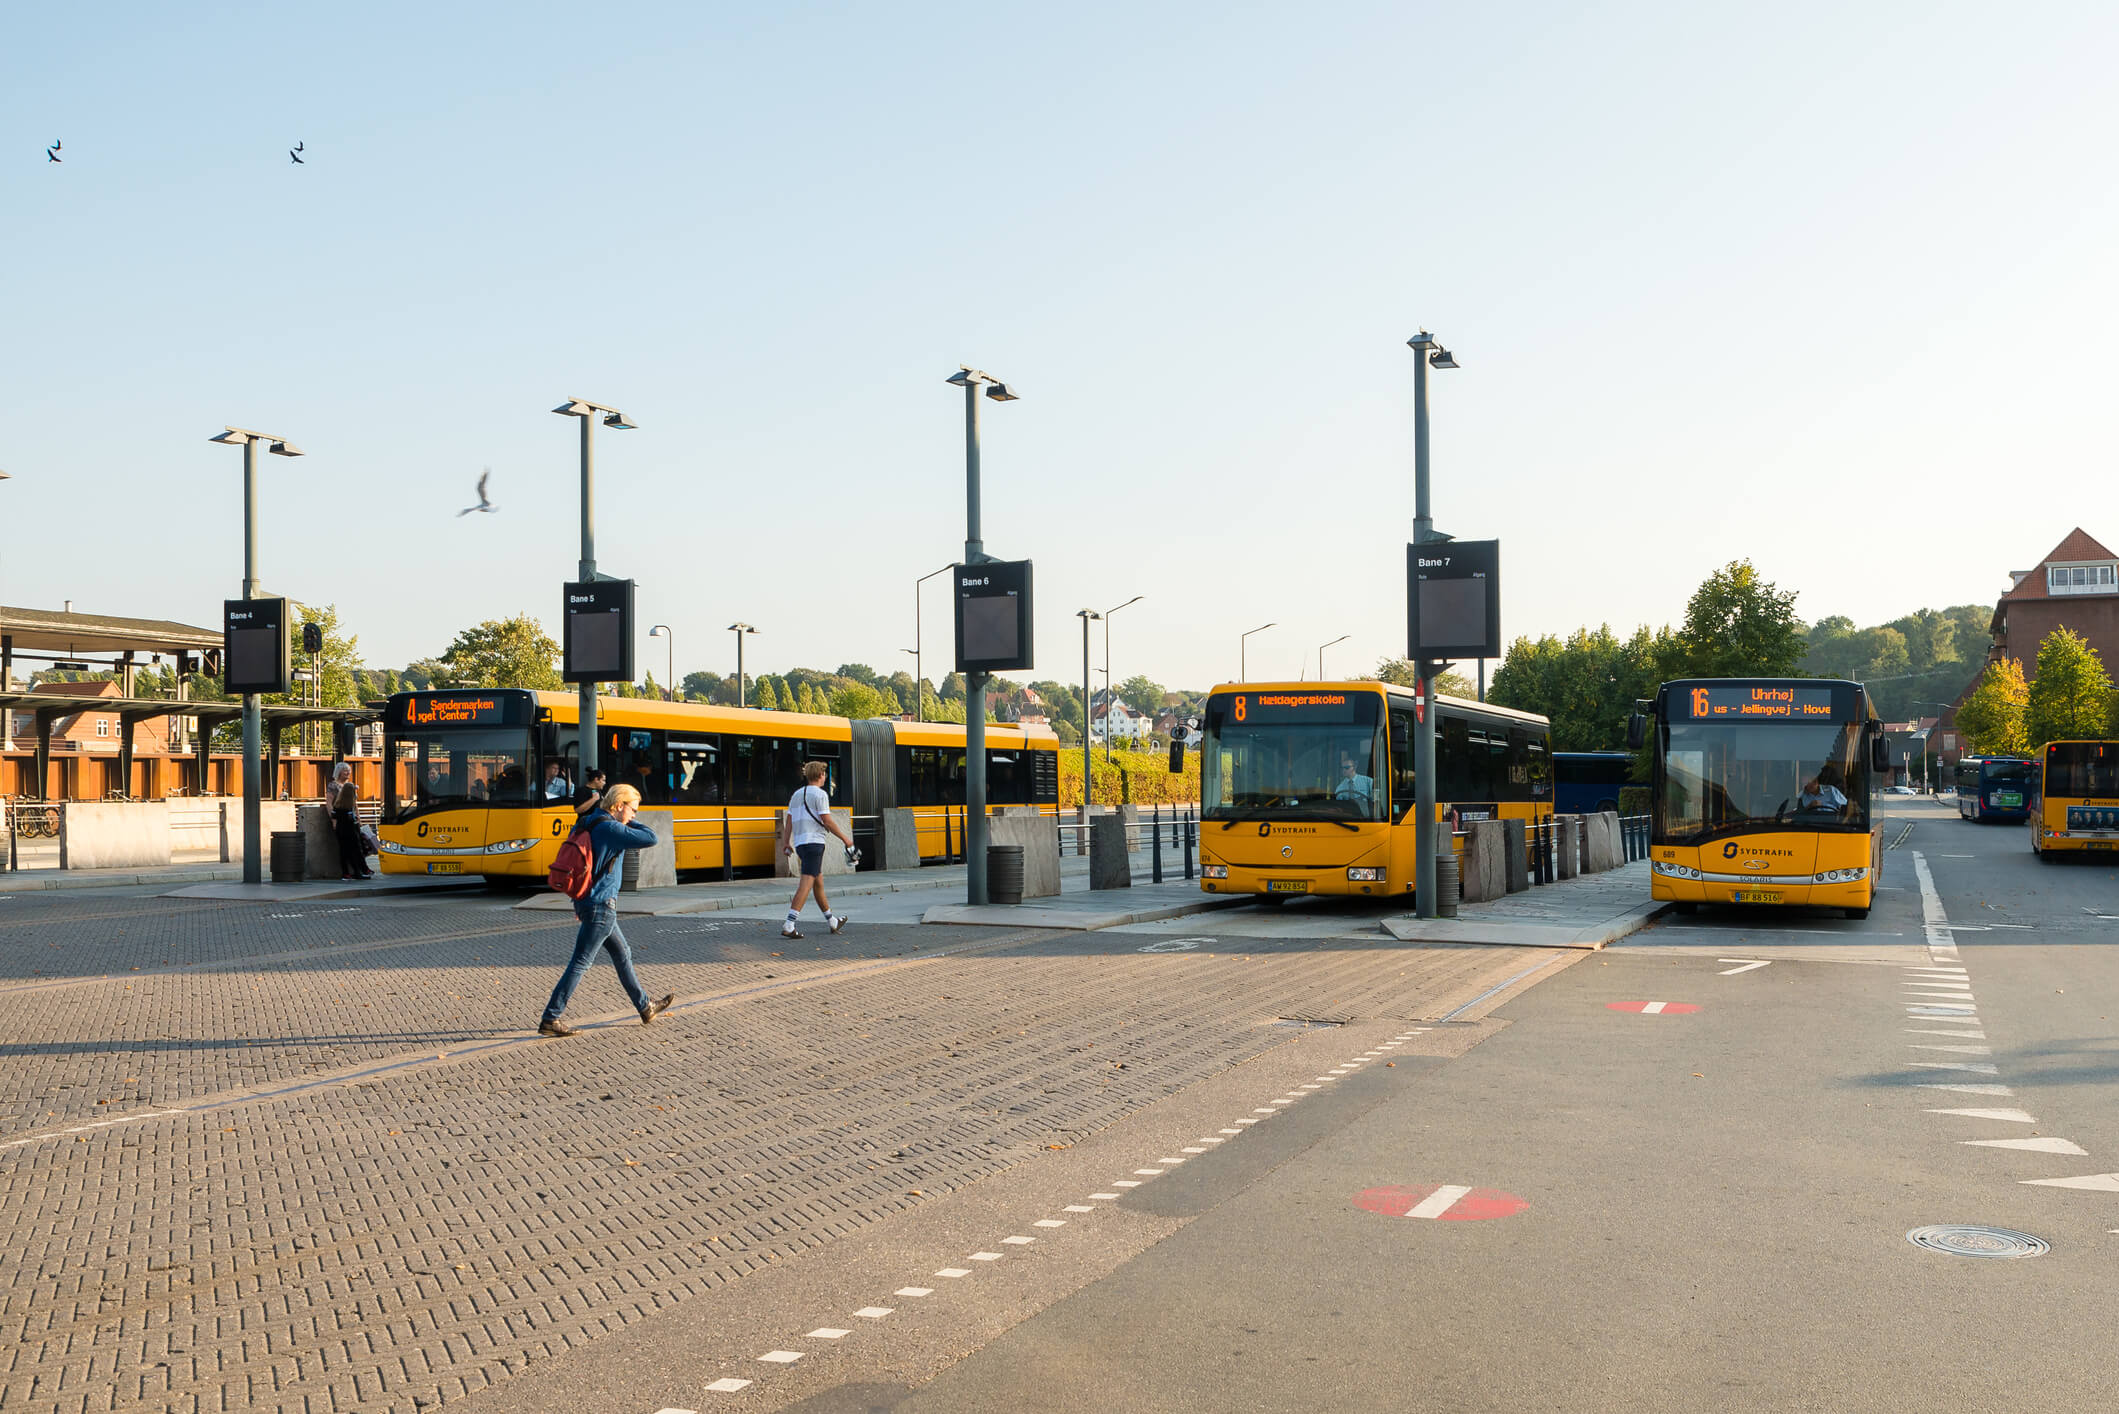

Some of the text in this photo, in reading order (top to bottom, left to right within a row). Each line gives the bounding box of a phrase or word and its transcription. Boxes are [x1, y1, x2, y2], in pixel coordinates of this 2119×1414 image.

[1418, 557, 1451, 567] Bane 7
[962, 577, 989, 586] Bane 6
[570, 595, 588, 603] Bane
[230, 612, 247, 620] Bane
[1258, 694, 1345, 707] Hældagerskolen
[1751, 688, 1794, 703] Uhrhøj
[430, 698, 495, 711] Søndermarken
[1234, 695, 1246, 721] 8
[1691, 688, 1709, 717] 16
[407, 698, 417, 725] 4
[1713, 705, 1728, 714] us
[1740, 703, 1791, 716] Jellingvej
[440, 710, 470, 721] Center
[1740, 848, 1794, 857] SYDTRAFIK
[1283, 881, 1292, 890] 92
[1740, 876, 1774, 884] SOLARIS
[1740, 893, 1778, 902] BF 88 516
[1716, 958, 1772, 976] 7
